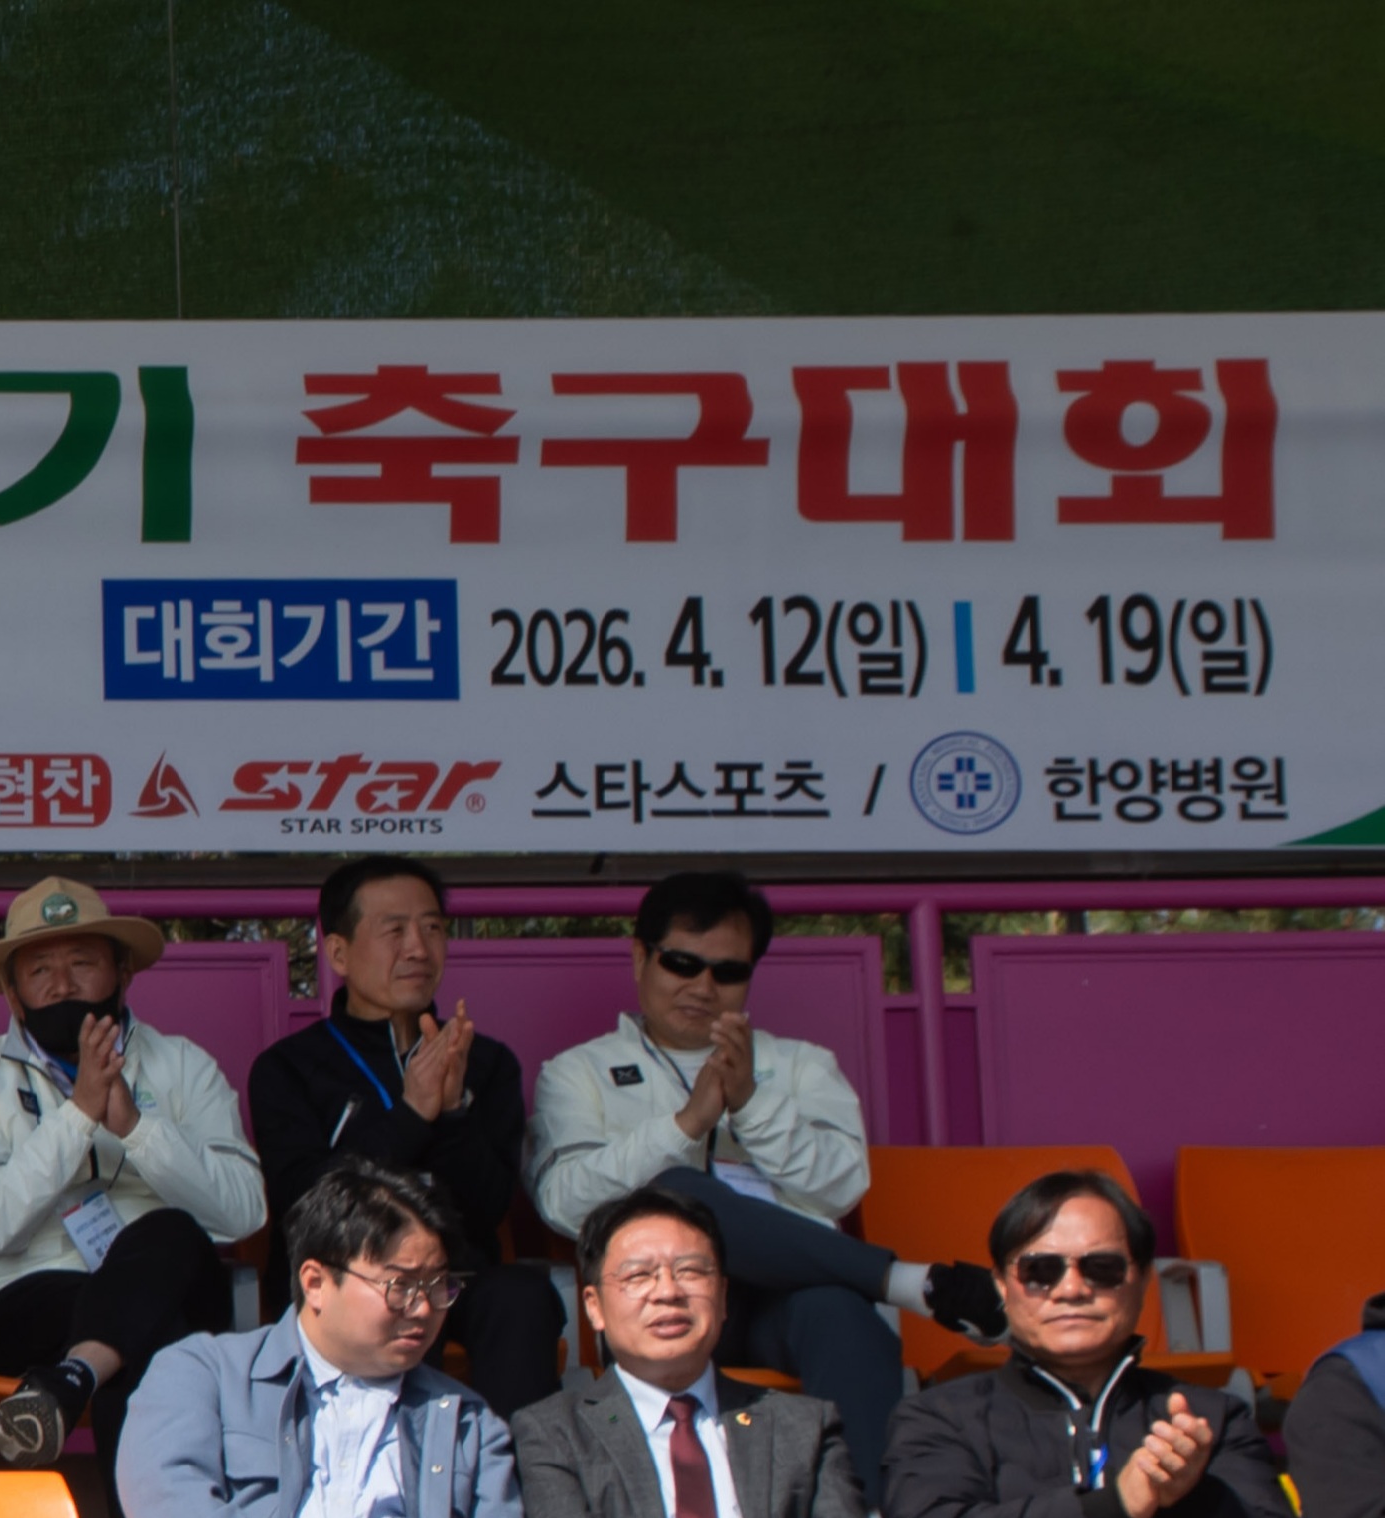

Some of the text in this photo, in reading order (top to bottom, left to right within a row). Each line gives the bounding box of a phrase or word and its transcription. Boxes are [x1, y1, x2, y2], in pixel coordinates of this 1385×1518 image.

[295, 359, 1279, 544] 축구대회
[122, 598, 440, 682] 대회기간
[491, 605, 645, 689] 2026.
[748, 593, 928, 696] 12(일)
[1085, 590, 1274, 696] 19(일)
[281, 818, 443, 835] STAR SPORTS
[532, 758, 828, 821] 스타스포츠
[1044, 755, 1290, 824] 한양병원
